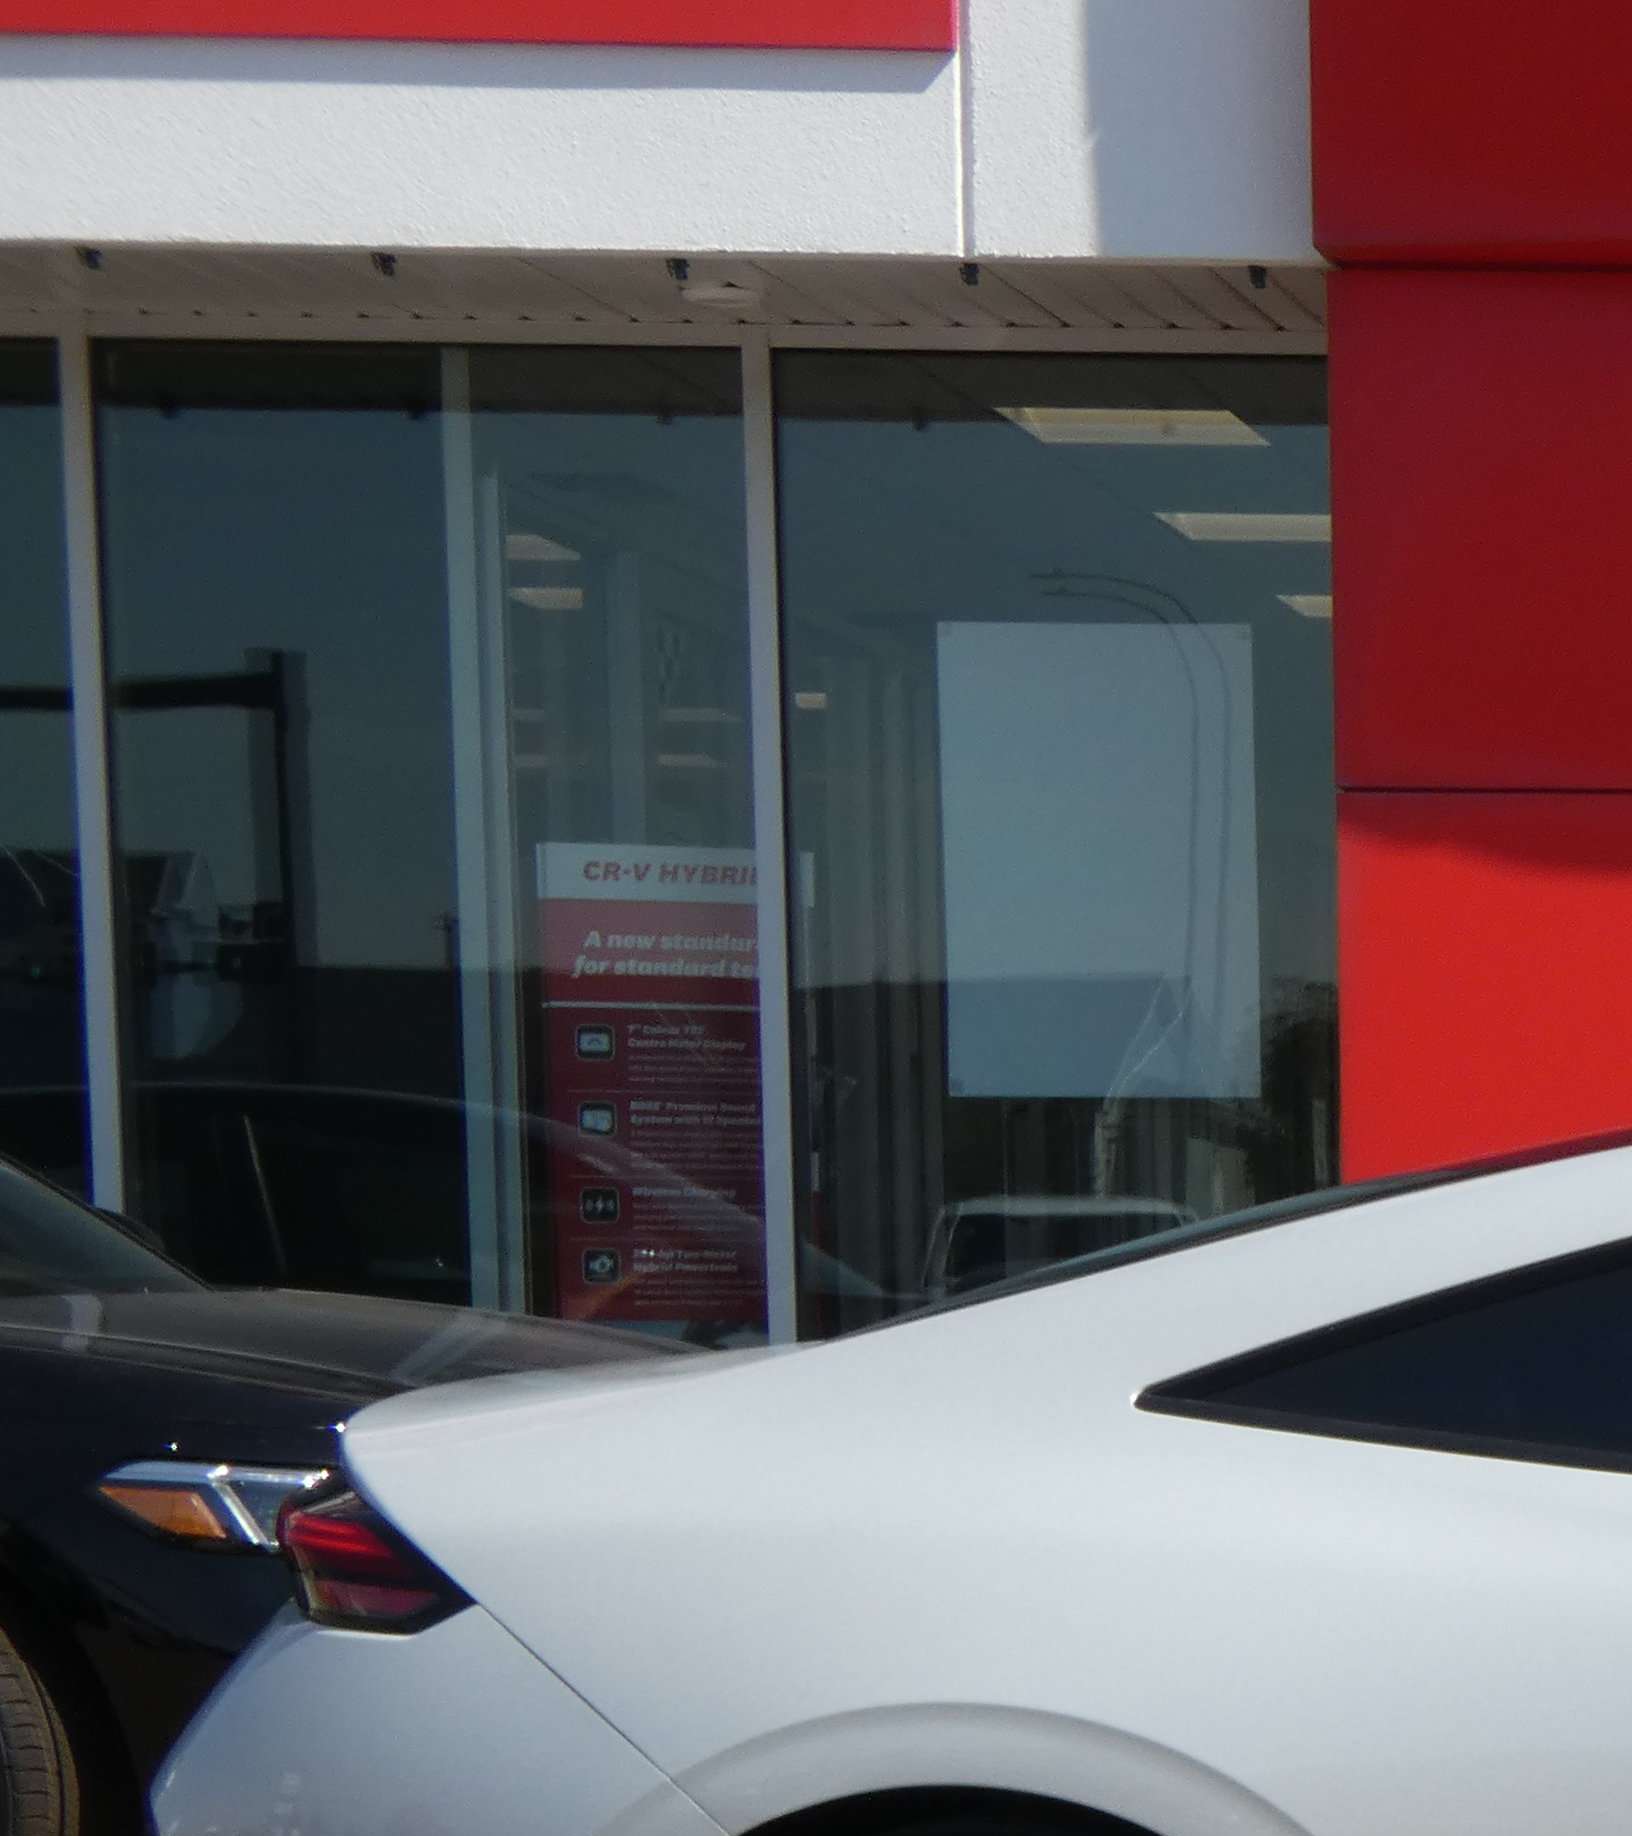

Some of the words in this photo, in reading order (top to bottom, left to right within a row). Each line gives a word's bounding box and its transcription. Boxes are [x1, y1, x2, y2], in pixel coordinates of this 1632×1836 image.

[583, 861, 652, 882] CR-V
[583, 931, 601, 948] A
[607, 934, 656, 949] new
[660, 934, 757, 952] standar
[570, 955, 610, 979] for
[614, 958, 727, 977] standard
